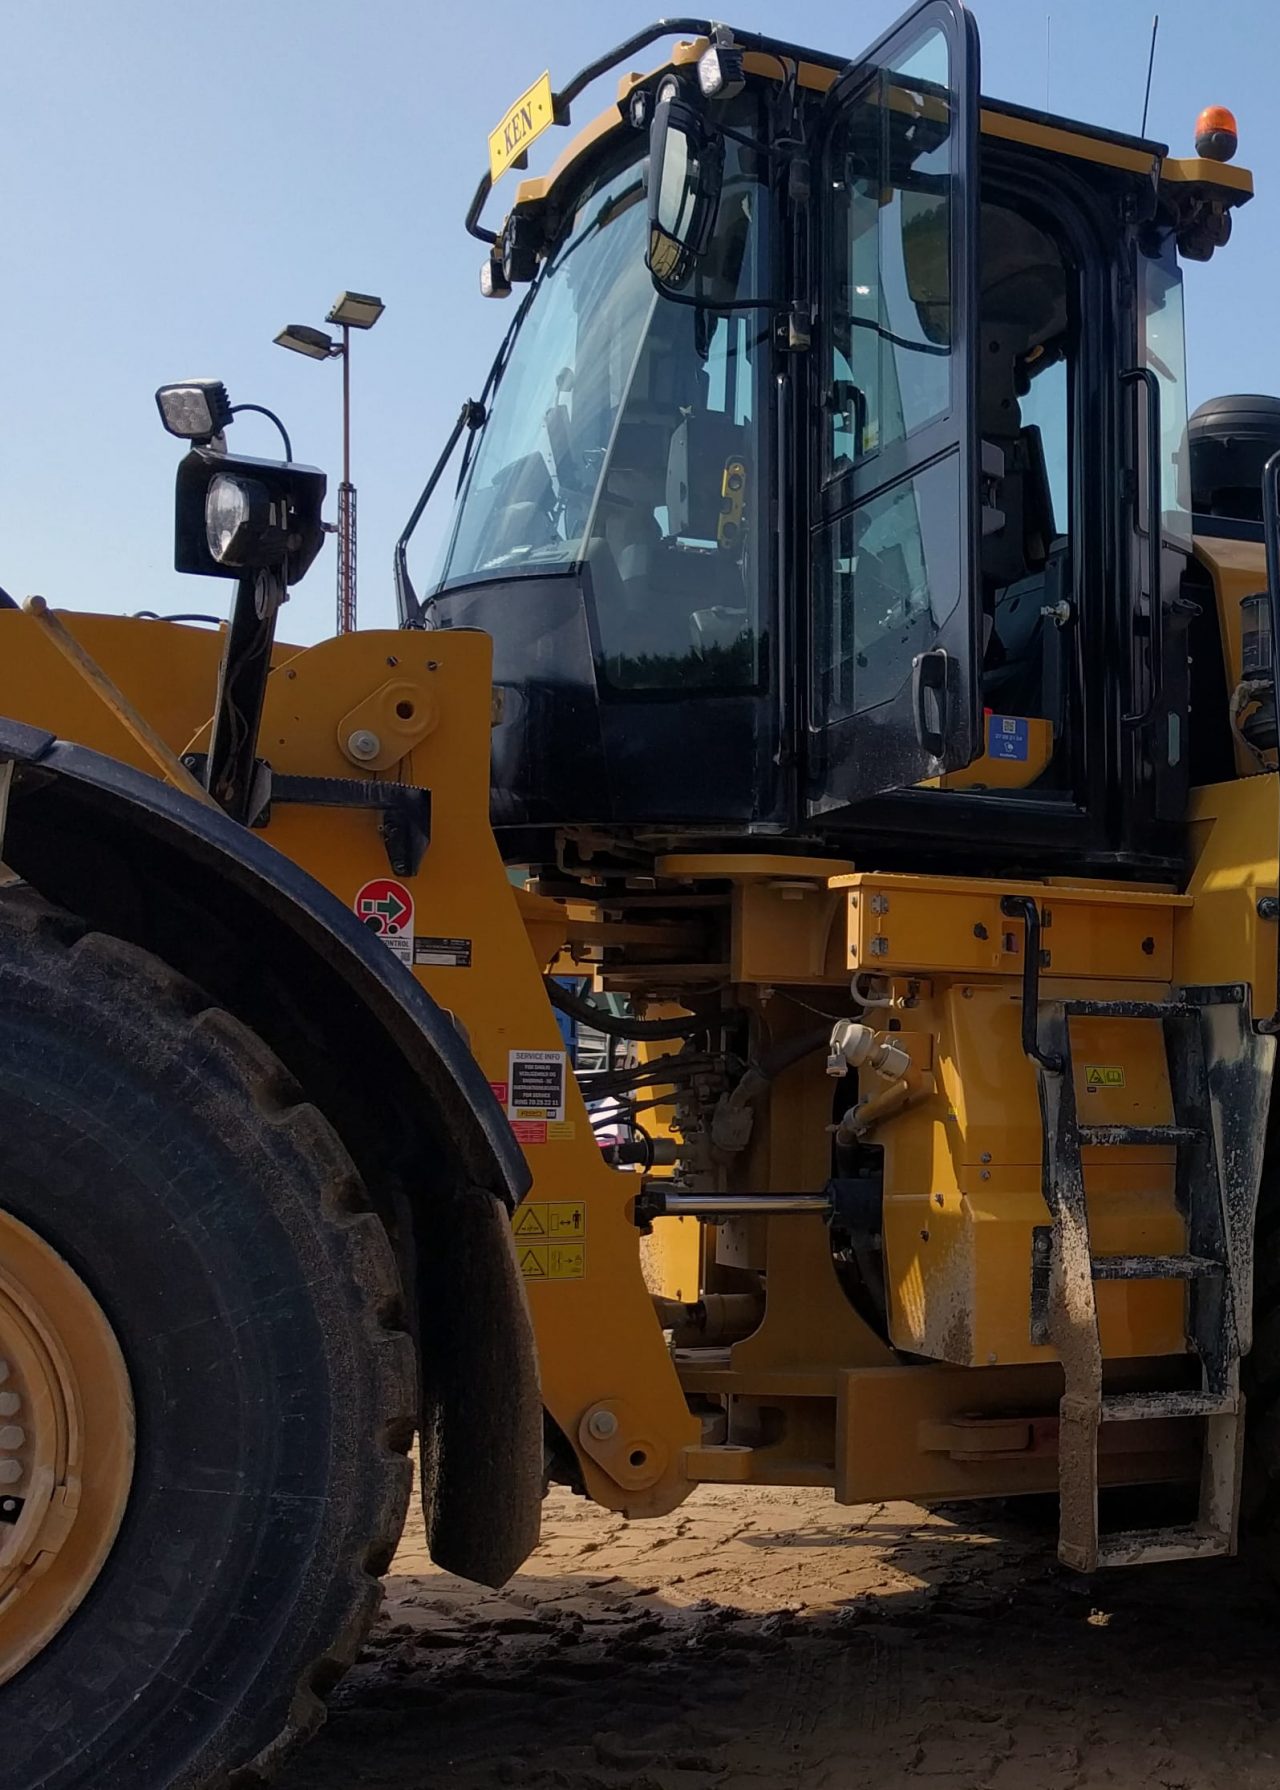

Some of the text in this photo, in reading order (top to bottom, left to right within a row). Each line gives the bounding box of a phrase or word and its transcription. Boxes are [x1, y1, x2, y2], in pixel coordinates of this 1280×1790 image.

[504, 101, 533, 157] KEN
[384, 939, 409, 948] ONTROL
[516, 1052, 561, 1061] SERVICE INFO
